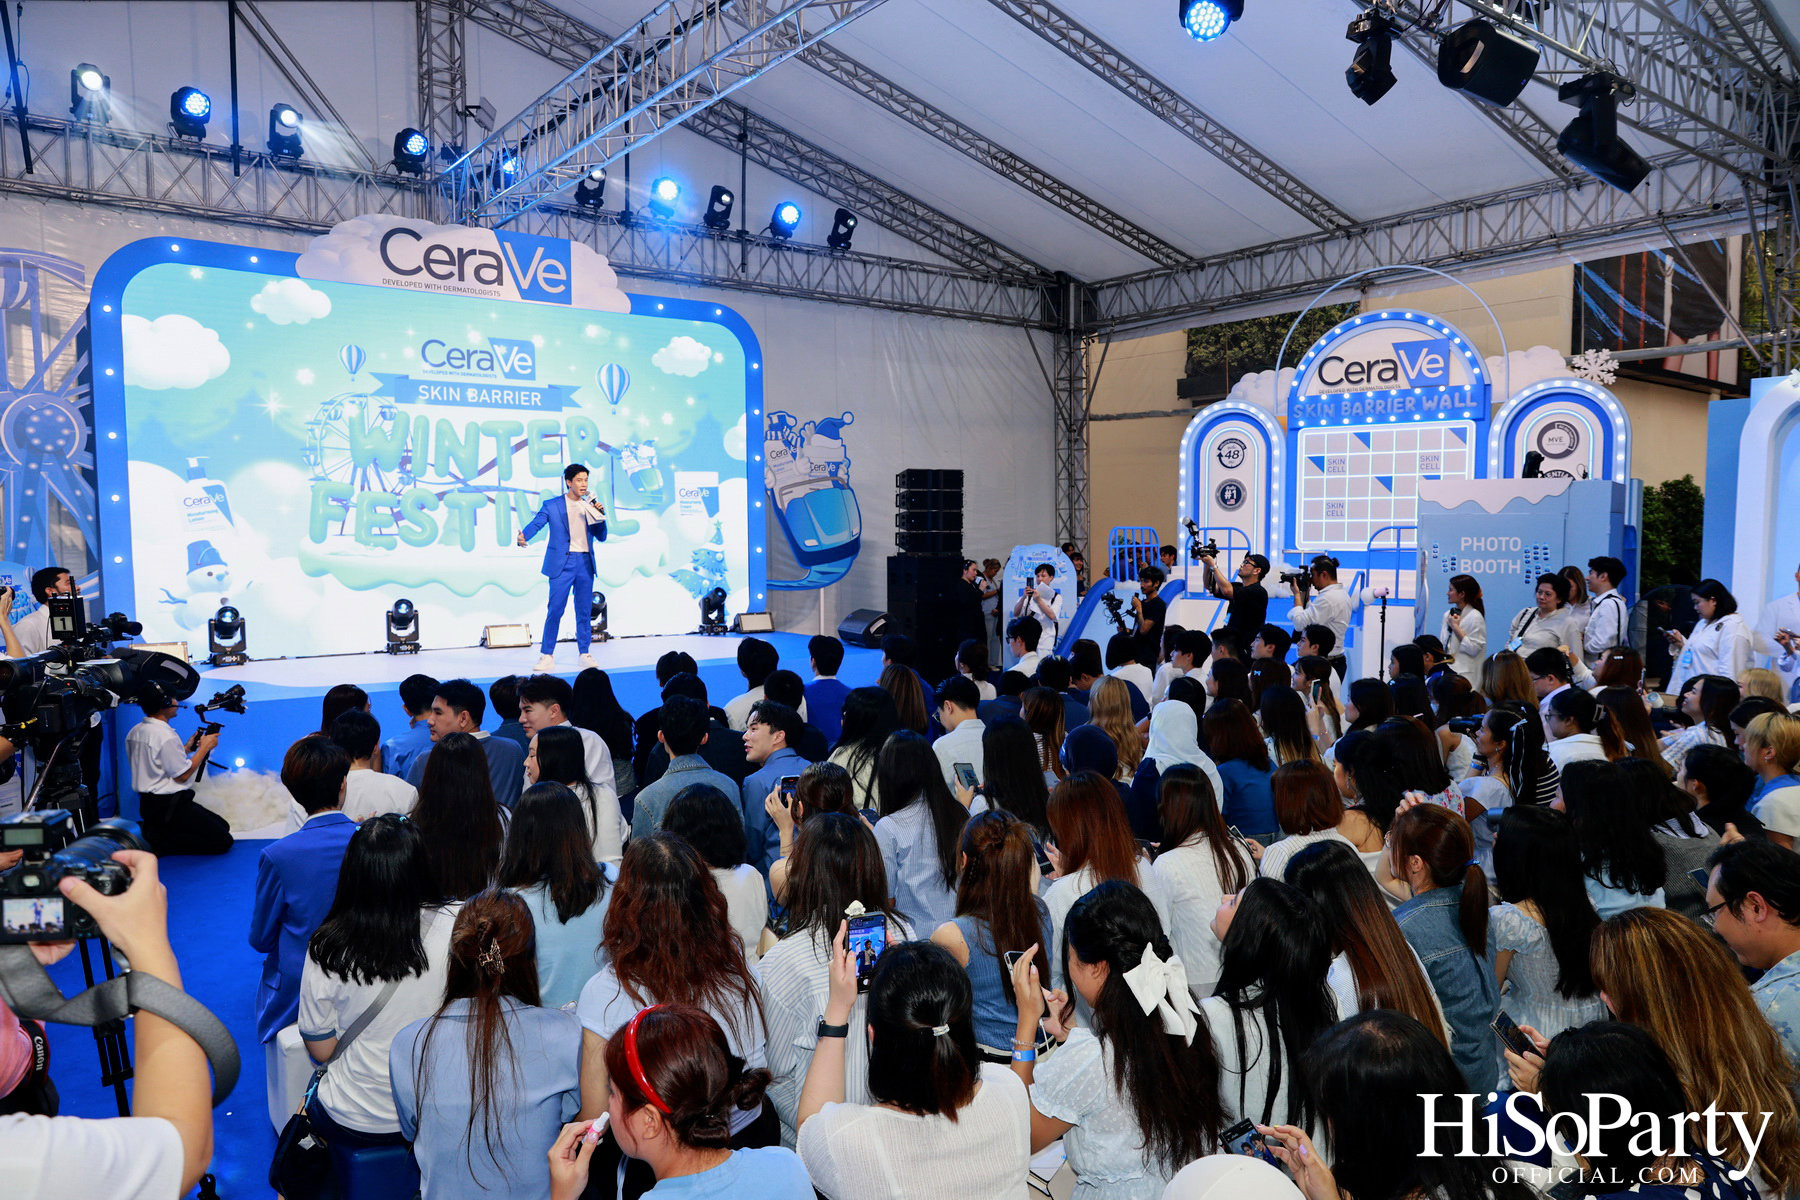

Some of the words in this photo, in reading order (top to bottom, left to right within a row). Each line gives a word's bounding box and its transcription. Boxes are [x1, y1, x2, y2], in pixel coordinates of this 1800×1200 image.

[380, 227, 567, 294] CeraVe
[382, 278, 423, 289] DEVELOPED
[424, 283, 442, 292] WITH
[443, 285, 501, 297] DERMATOLOGISTS
[421, 339, 533, 375] CeraVe
[1318, 347, 1445, 386] CeraVe
[418, 385, 460, 402] SKIN
[467, 388, 542, 407] BARRIER
[1293, 402, 1335, 419] SKIN
[1341, 397, 1416, 416] BARRIER
[1422, 392, 1478, 411] WALL
[350, 404, 601, 482] WINTER
[1224, 449, 1240, 460] 48
[1327, 458, 1346, 466] SKIN
[1420, 462, 1440, 470] CELL
[183, 492, 225, 507] CeraVe
[679, 487, 710, 498] CeraVe
[1224, 489, 1237, 500] #1
[1326, 502, 1344, 510] SKIN
[309, 479, 641, 553] FESTIVL
[1461, 536, 1522, 552] PHOTO
[1460, 559, 1521, 574] BOOTH
[59, 617, 66, 631] 1
[34, 1036, 45, 1071] Canon
